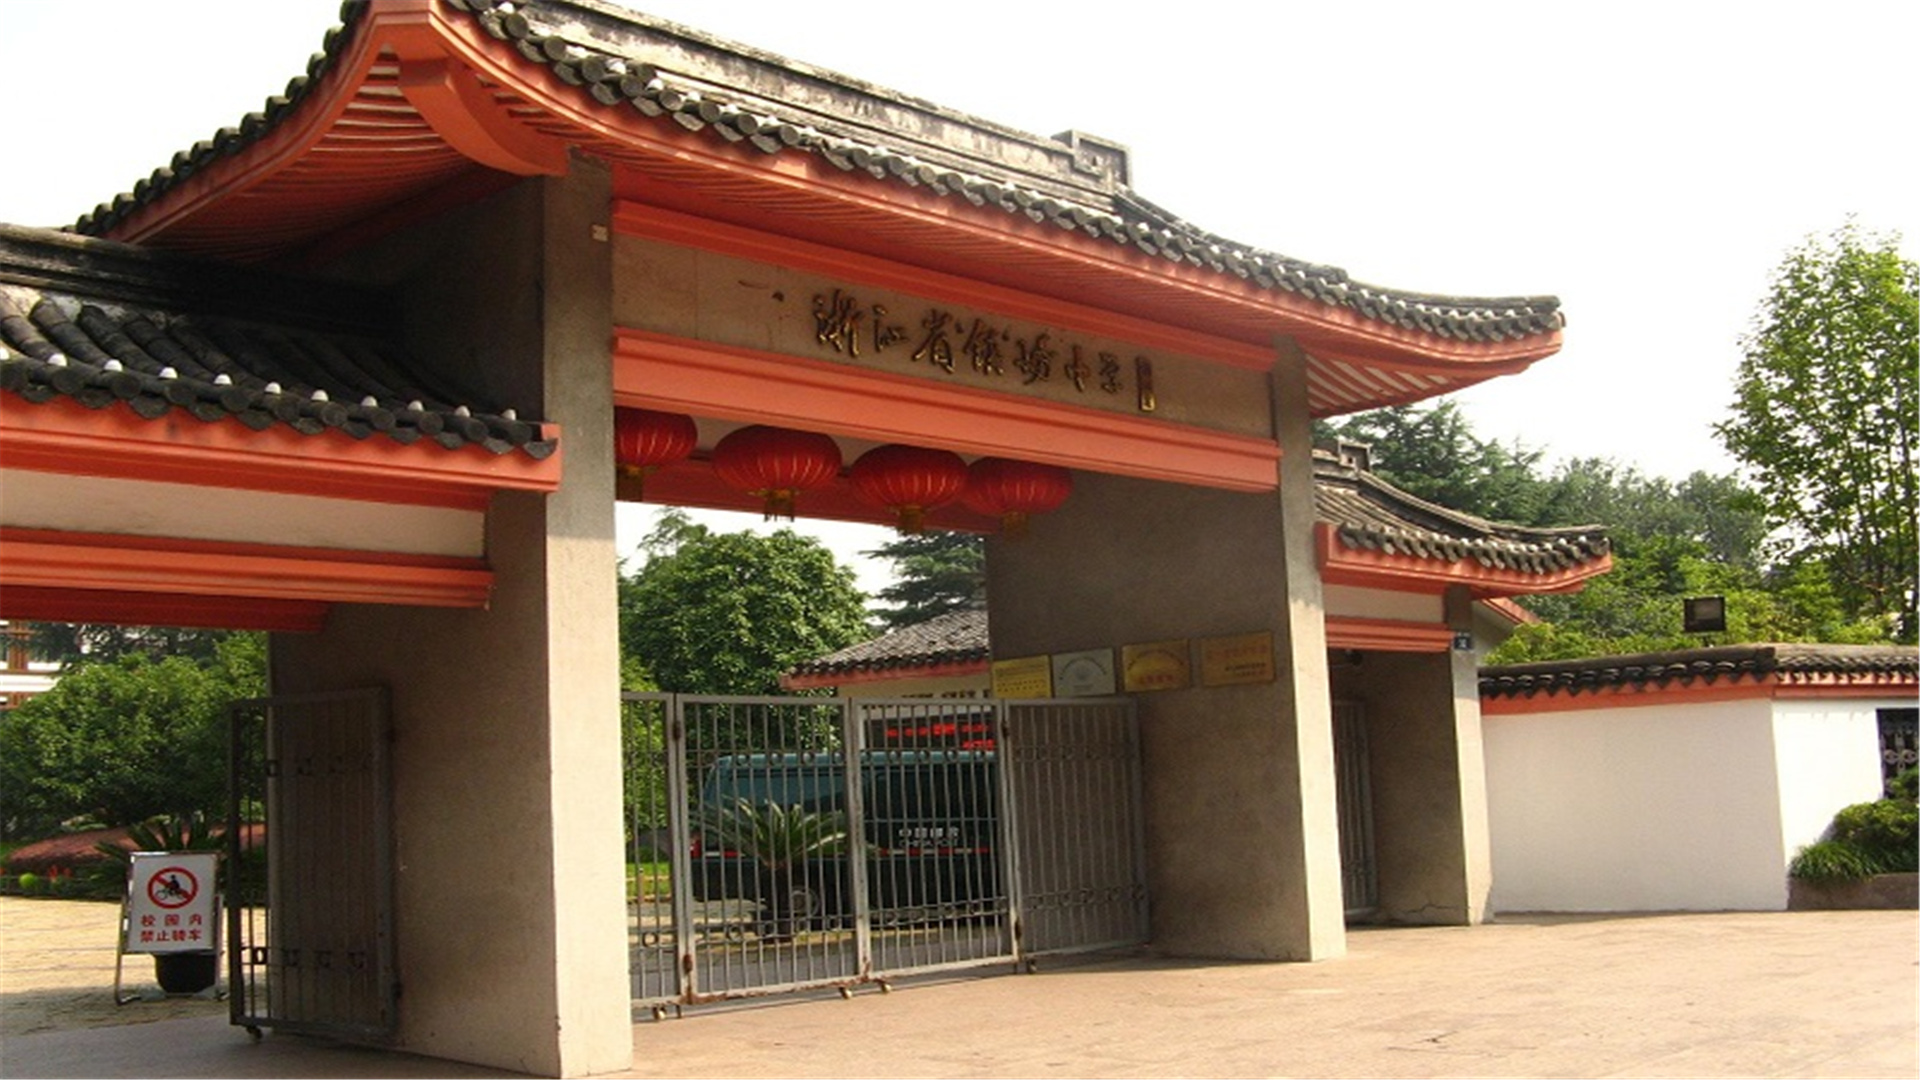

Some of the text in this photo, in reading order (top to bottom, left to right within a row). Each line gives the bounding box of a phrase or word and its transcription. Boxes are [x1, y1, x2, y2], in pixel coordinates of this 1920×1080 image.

[140, 914, 202, 927] 校园内
[140, 930, 202, 943] 禁止骑车
